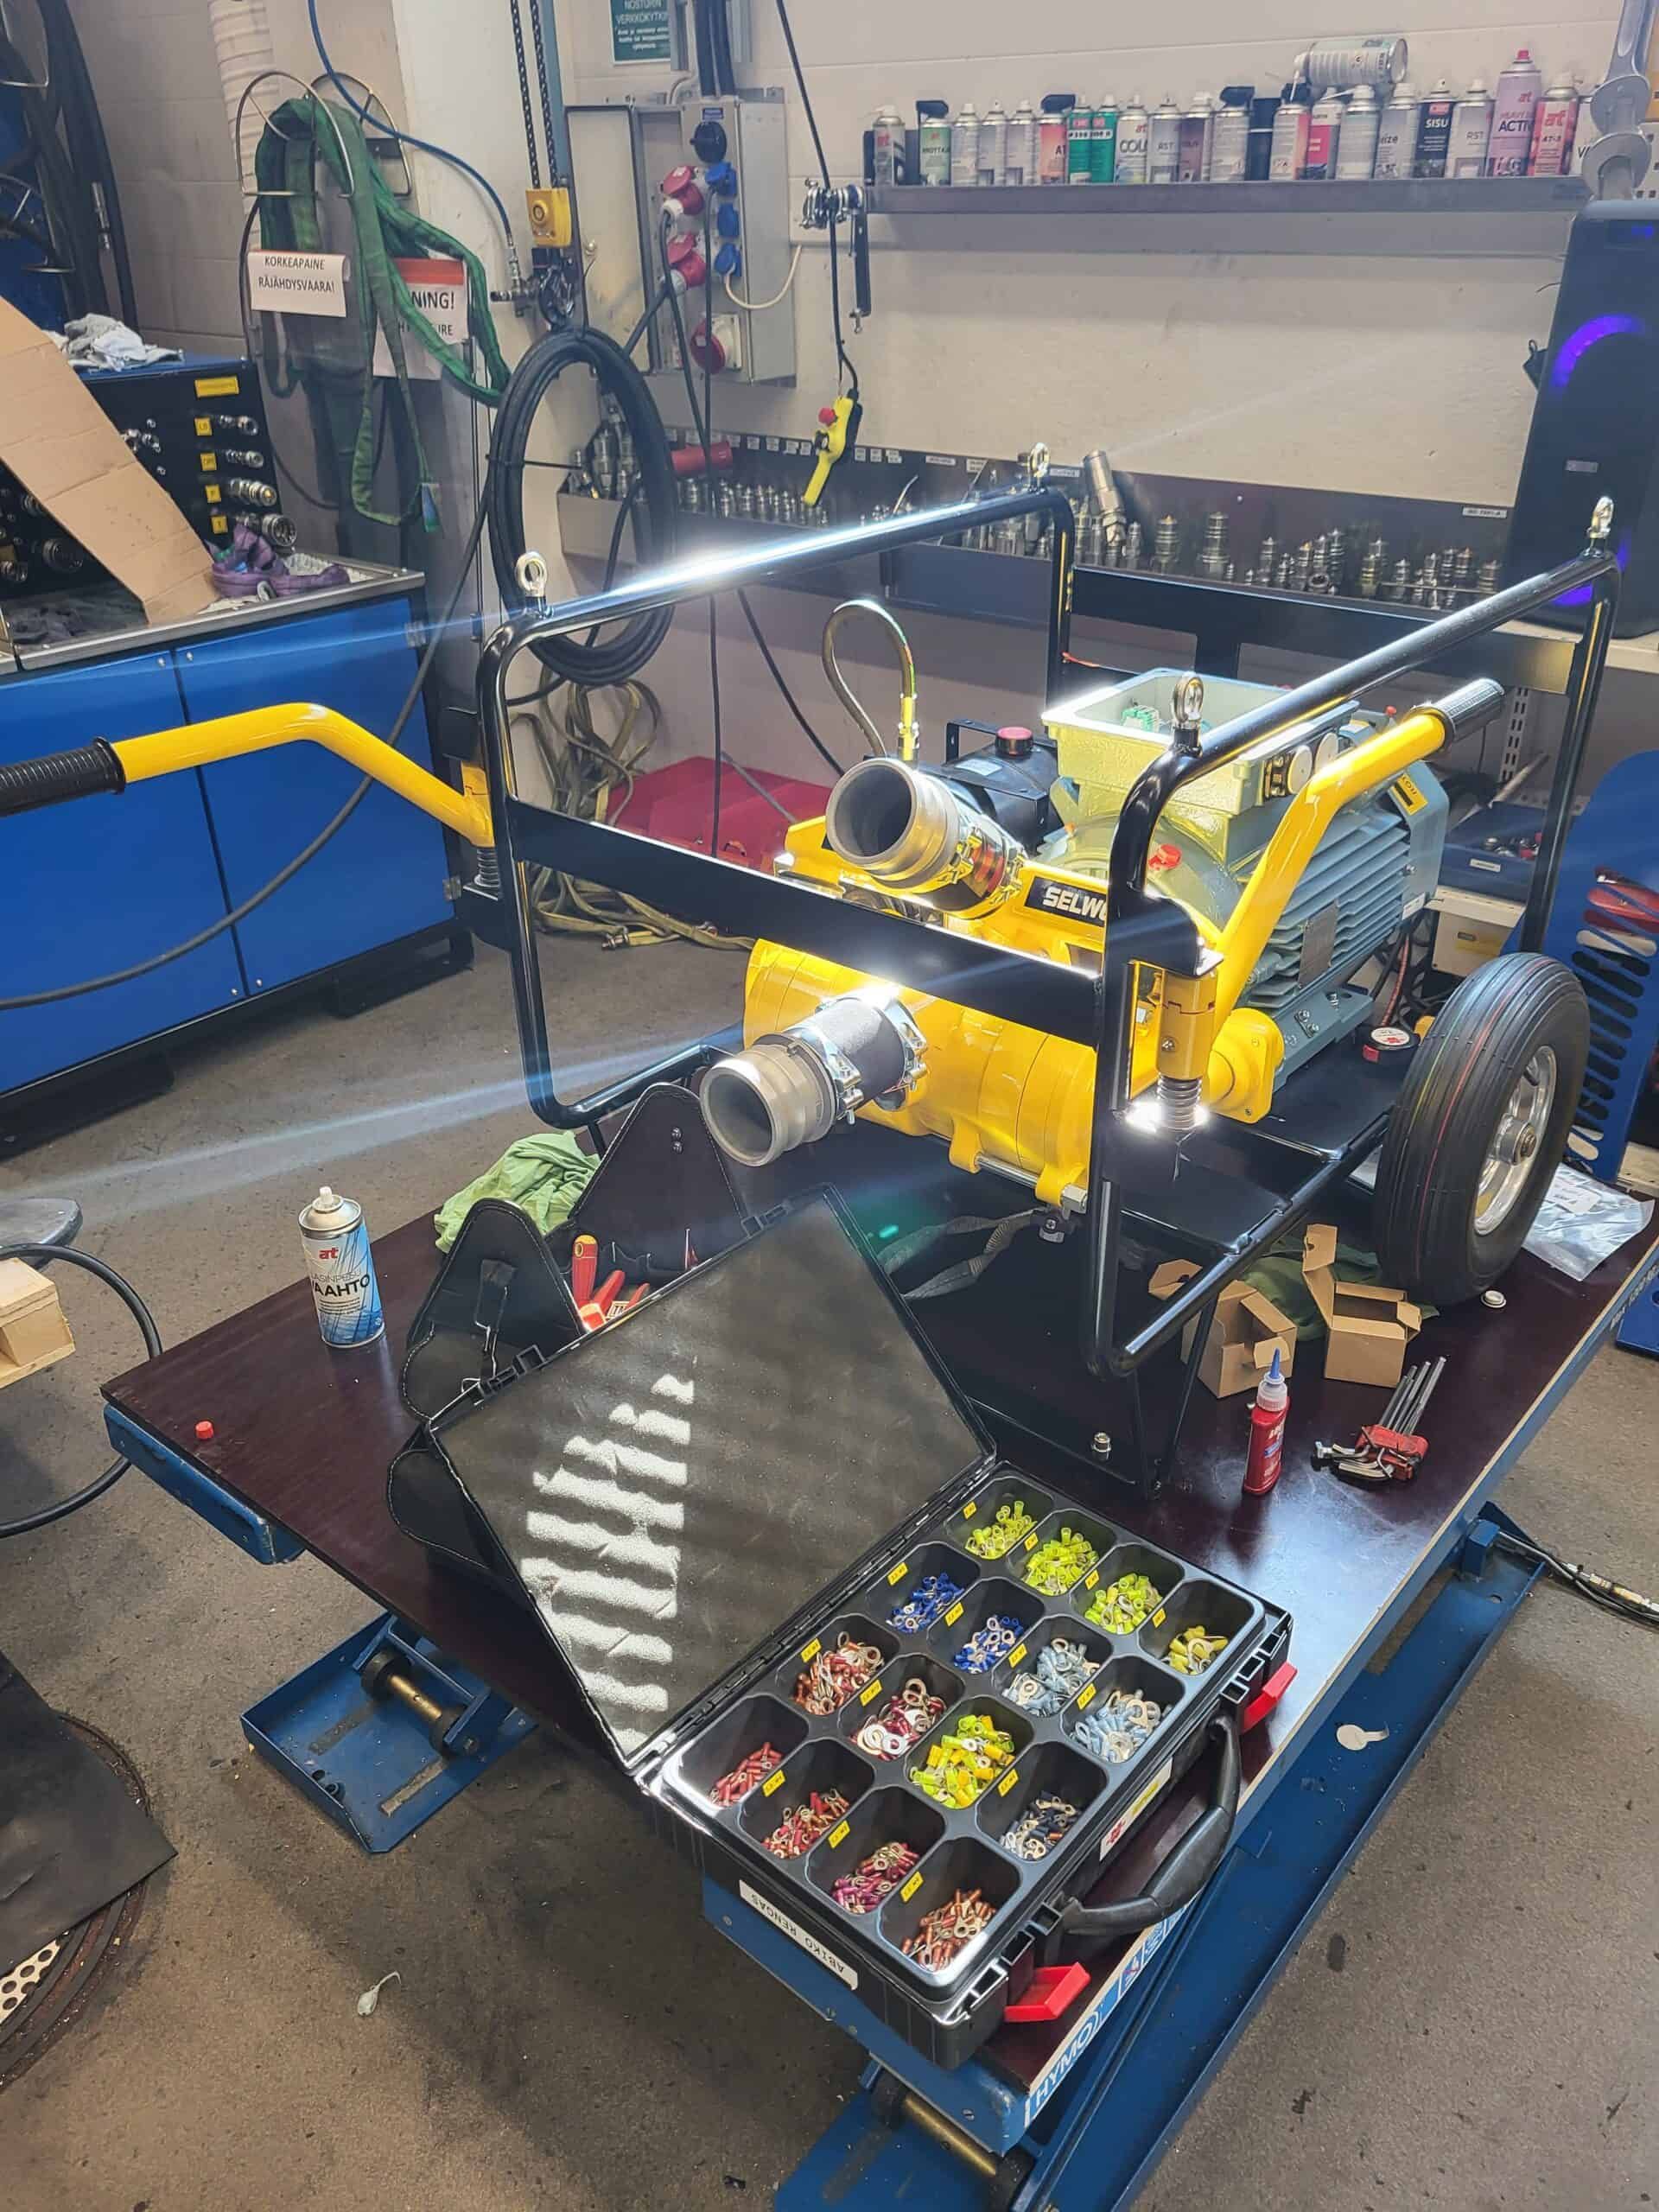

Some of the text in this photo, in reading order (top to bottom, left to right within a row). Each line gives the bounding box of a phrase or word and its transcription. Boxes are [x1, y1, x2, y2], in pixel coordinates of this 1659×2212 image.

[1425, 118, 1450, 129] SISU
[1545, 110, 1566, 127] at
[1466, 130, 1484, 140] RST
[264, 255, 325, 270] KORKEAPAINE
[258, 276, 335, 292] RÄJÄHDYSVAARA!
[319, 1247, 339, 1260] at
[804, 1936, 845, 1974] ABIKO
[1035, 2022, 1094, 2107] HYMO
